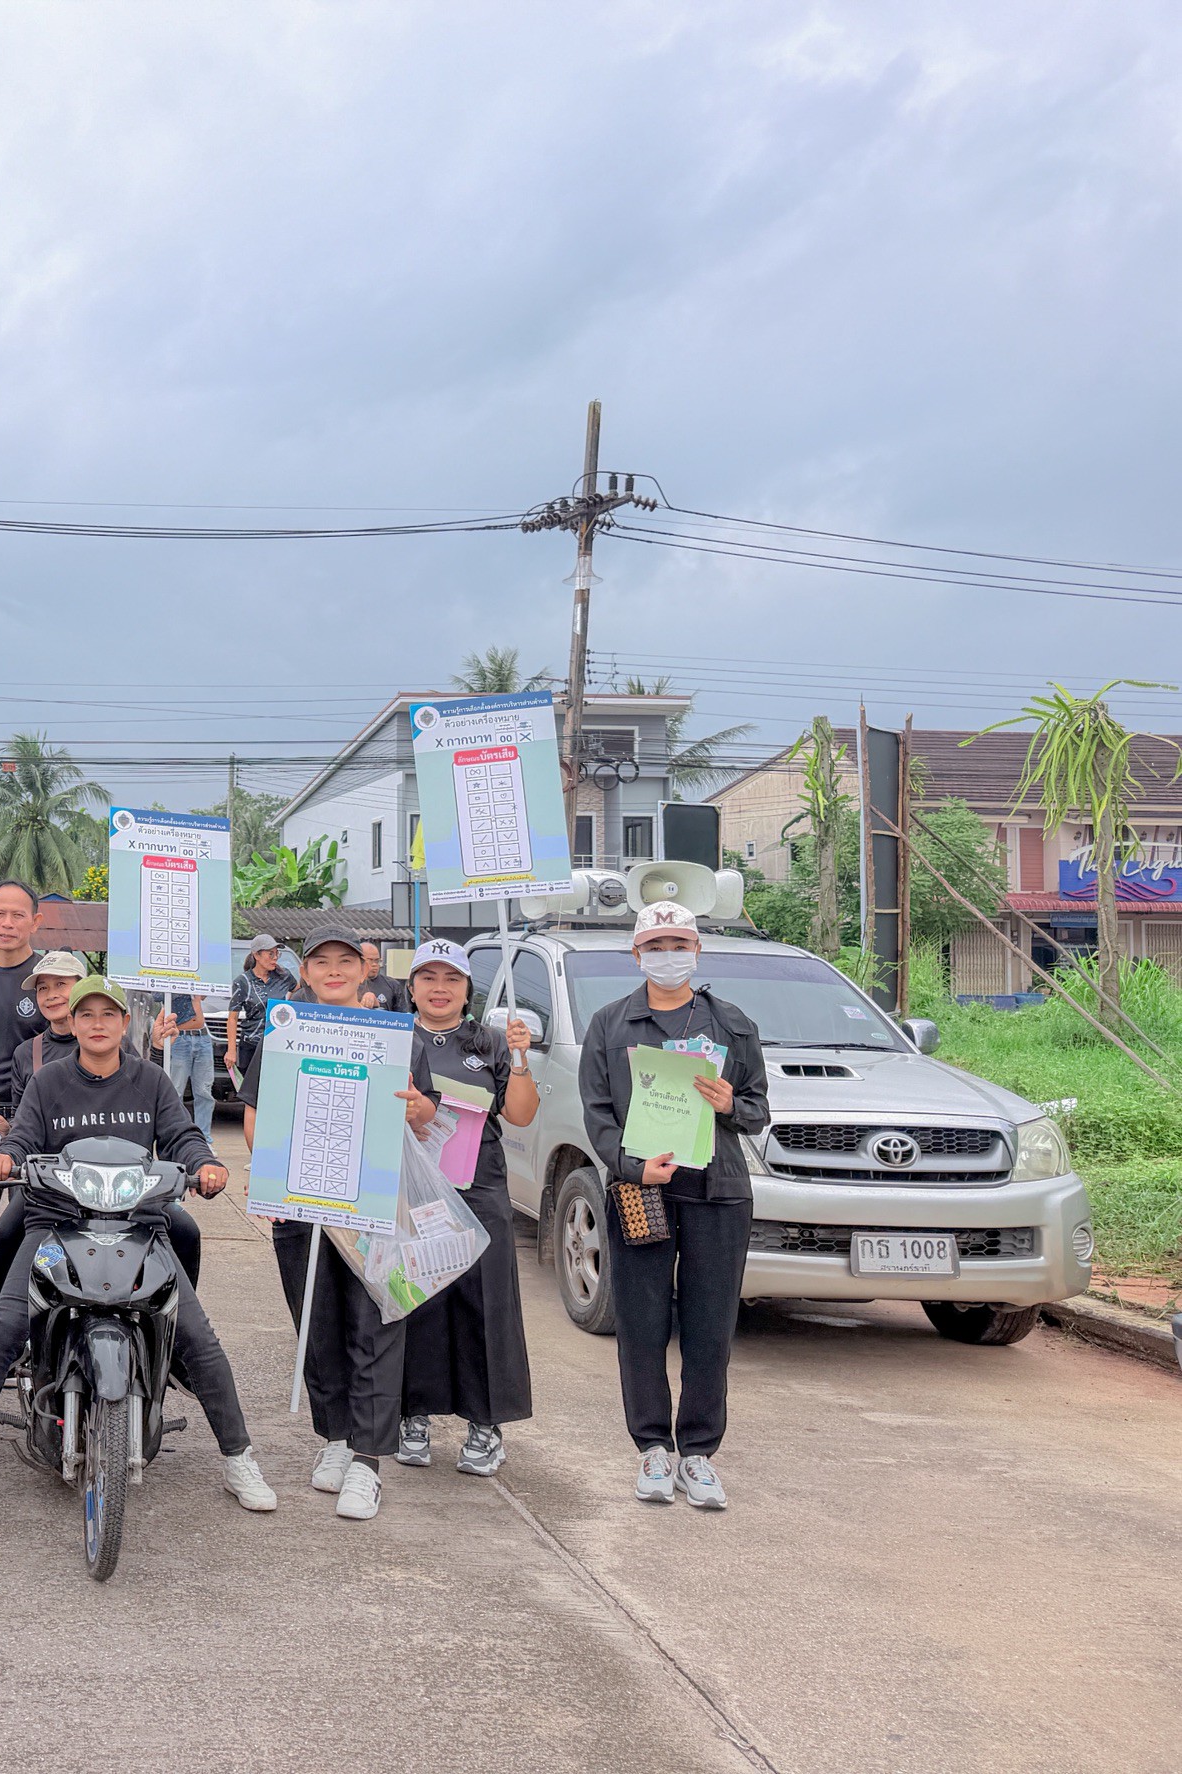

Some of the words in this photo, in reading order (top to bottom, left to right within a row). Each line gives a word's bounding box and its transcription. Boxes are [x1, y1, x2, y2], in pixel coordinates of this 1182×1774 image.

[444, 714, 520, 729] ตัวอย่างเครื่องหมาย
[447, 734, 492, 747] กากบาท
[138, 825, 202, 839] ตัวอย่างเครื่องหมาย
[138, 843, 177, 853] กากบาท
[654, 911, 676, 925] M
[431, 942, 451, 955] NY
[299, 1022, 376, 1040] ตัวอย่างเครื่องหมาย
[297, 1041, 344, 1055] กากบาท
[333, 1064, 360, 1077] บัตรดี
[649, 1089, 688, 1104] บัตรเลือกตั้ง
[642, 1100, 675, 1112] สมาชิกสภา
[52, 1116, 76, 1130] YOU
[81, 1113, 106, 1126] ARE
[111, 1111, 152, 1124] LOVED
[899, 1239, 948, 1260] 1008
